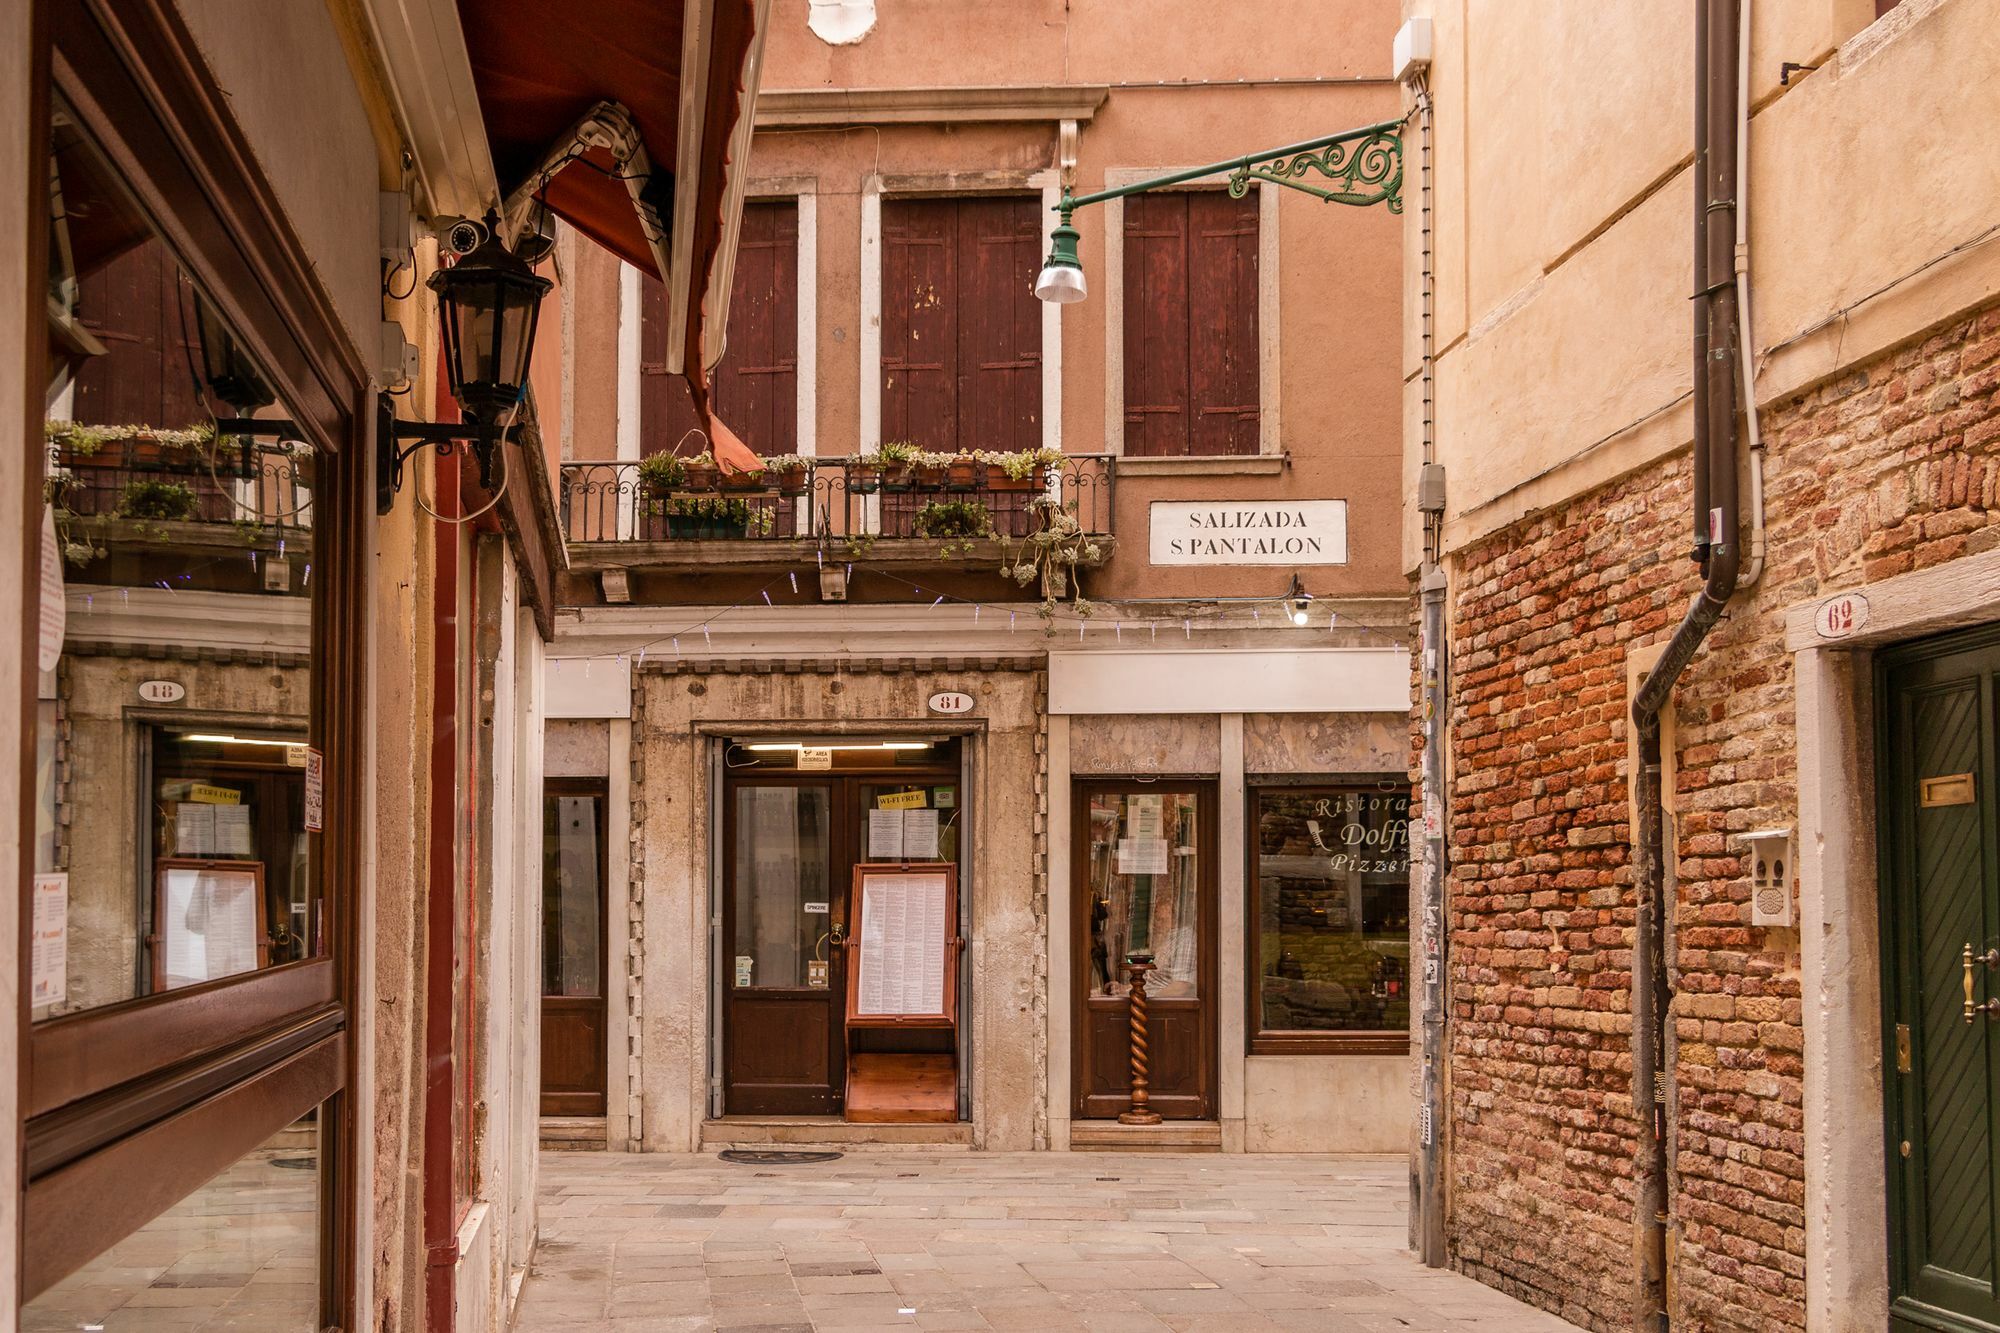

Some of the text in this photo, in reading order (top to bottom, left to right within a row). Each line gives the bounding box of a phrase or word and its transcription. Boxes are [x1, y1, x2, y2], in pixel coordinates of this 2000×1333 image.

[1189, 511, 1307, 529] SALIZADA
[1190, 537, 1322, 556] PANTALON
[940, 695, 960, 709] 81
[879, 794, 921, 805] WI-FI FREE
